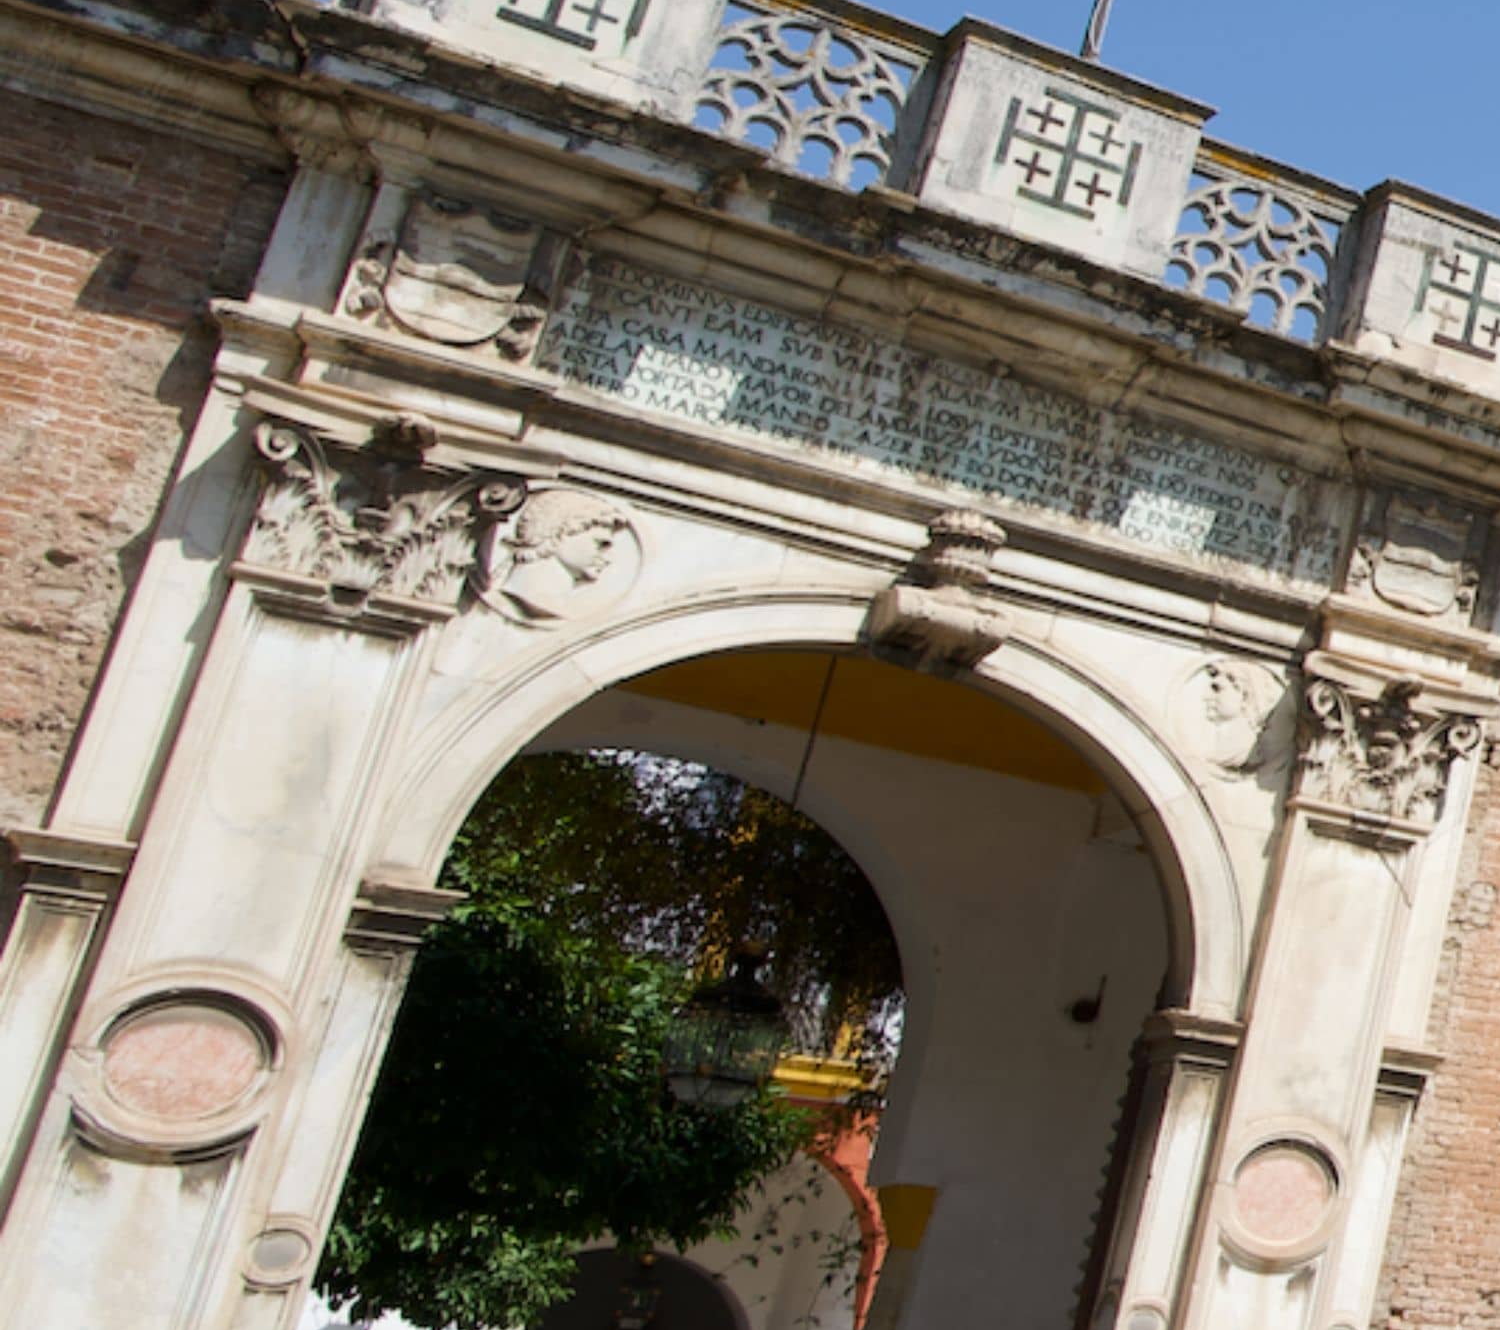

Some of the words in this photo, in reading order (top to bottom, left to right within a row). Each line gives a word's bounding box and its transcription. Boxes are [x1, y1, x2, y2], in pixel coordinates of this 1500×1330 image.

[618, 267, 737, 314] DOMINVS
[620, 316, 688, 350] CASA
[562, 343, 620, 374] ESTA
[623, 361, 732, 408] PORTADA
[736, 393, 830, 437] MANDO
[997, 467, 1047, 496] DON
[702, 313, 763, 345] EAM
[779, 335, 825, 363] SVB
[1216, 466, 1257, 492] NOS
